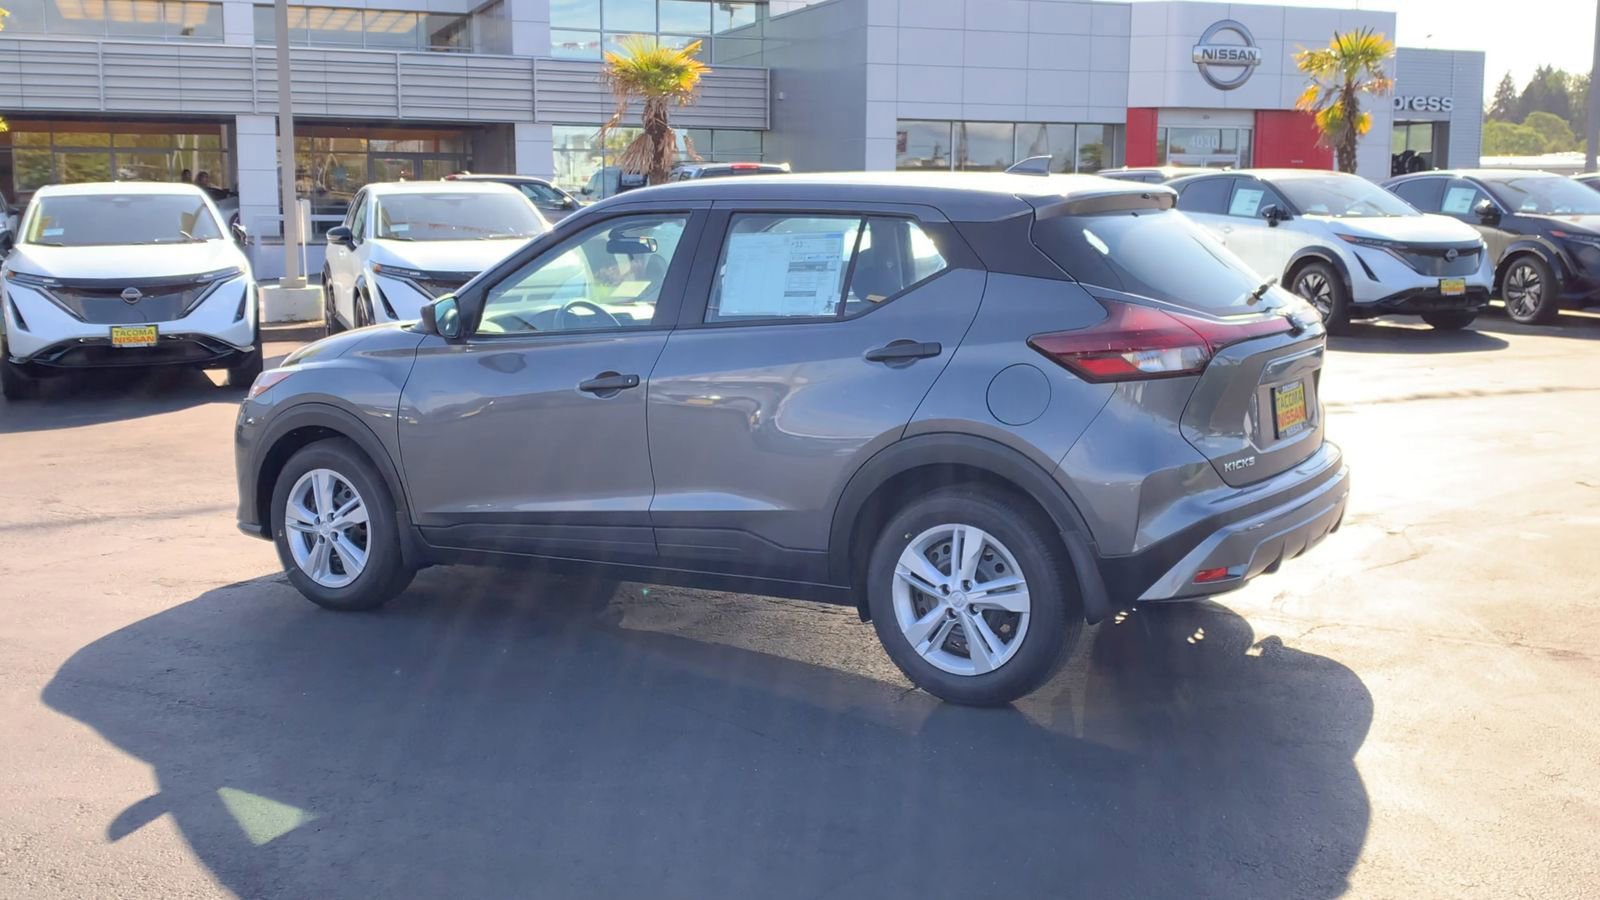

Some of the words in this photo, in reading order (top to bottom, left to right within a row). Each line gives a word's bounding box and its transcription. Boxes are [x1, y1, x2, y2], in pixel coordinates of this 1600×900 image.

[1201, 48, 1257, 61] NISSAN
[113, 329, 154, 337] TACOMA
[1276, 389, 1303, 410] TACOMA
[1278, 405, 1305, 427] NISSAN
[1224, 456, 1255, 472] KICKS
